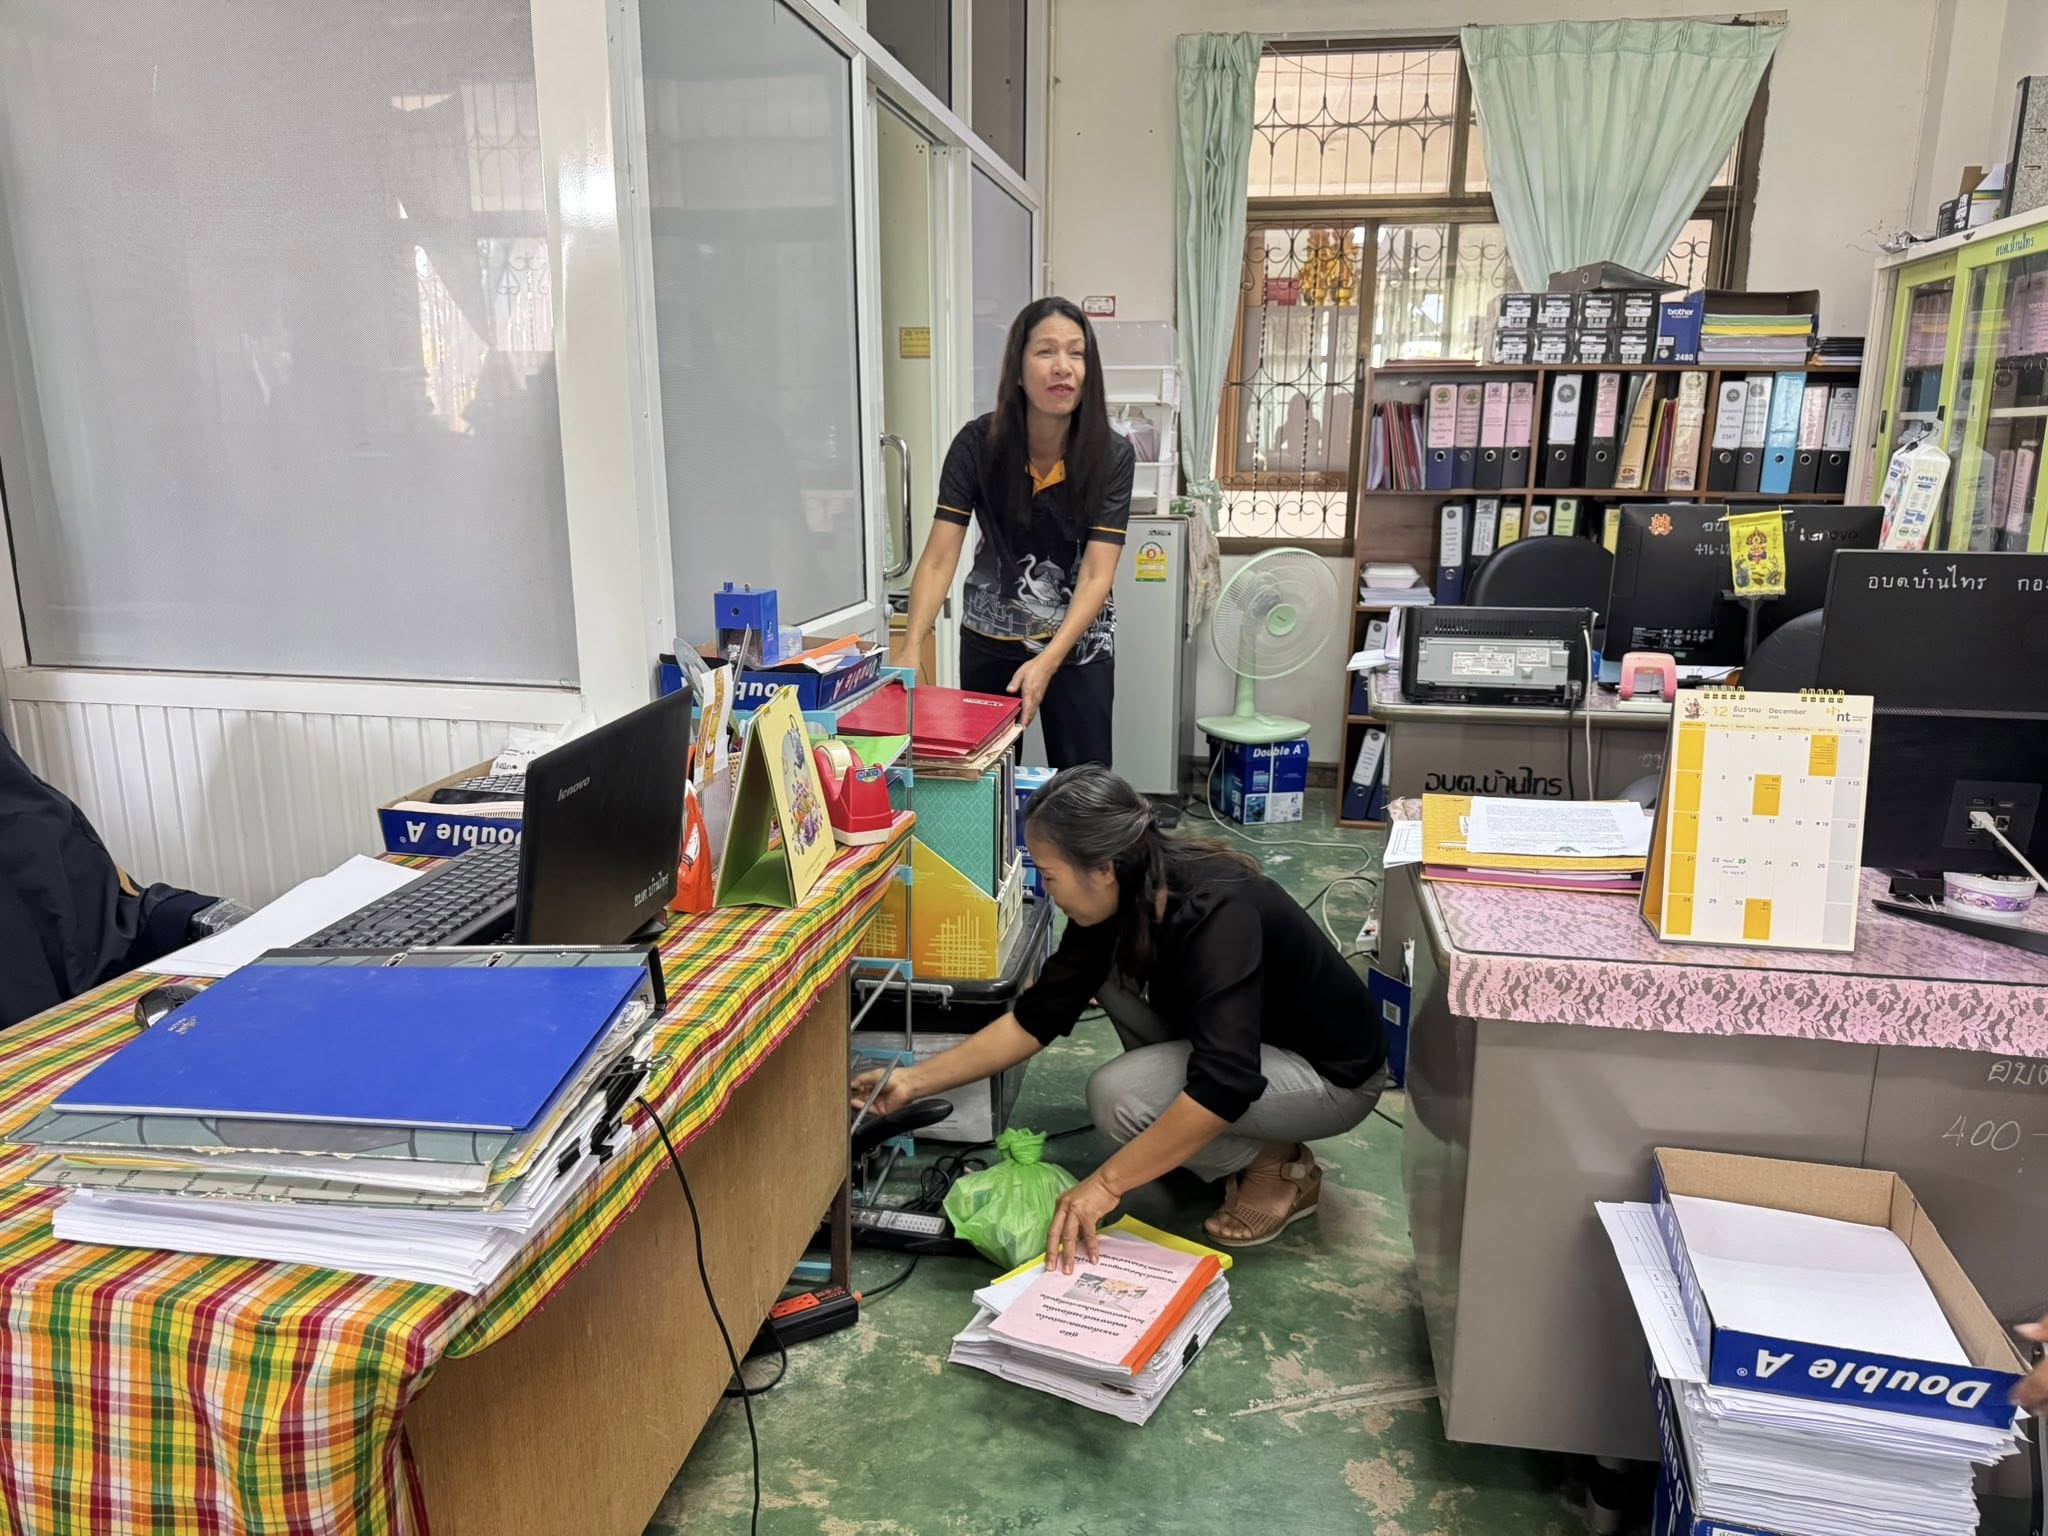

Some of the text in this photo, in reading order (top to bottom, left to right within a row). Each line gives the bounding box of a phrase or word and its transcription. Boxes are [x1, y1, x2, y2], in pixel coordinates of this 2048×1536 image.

[1668, 308, 1694, 316] brother
[2018, 577, 2048, 591] กอ
[1712, 706, 1728, 717] 12
[1732, 705, 1762, 714] ธันวาคม
[1837, 711, 1851, 722] nt
[1253, 744, 1302, 758] Double A
[1424, 766, 1562, 796] อบต.บ้านไทร
[558, 776, 590, 802] lenovo
[406, 820, 522, 847] ouble A
[1756, 1348, 1992, 1409] Double A
